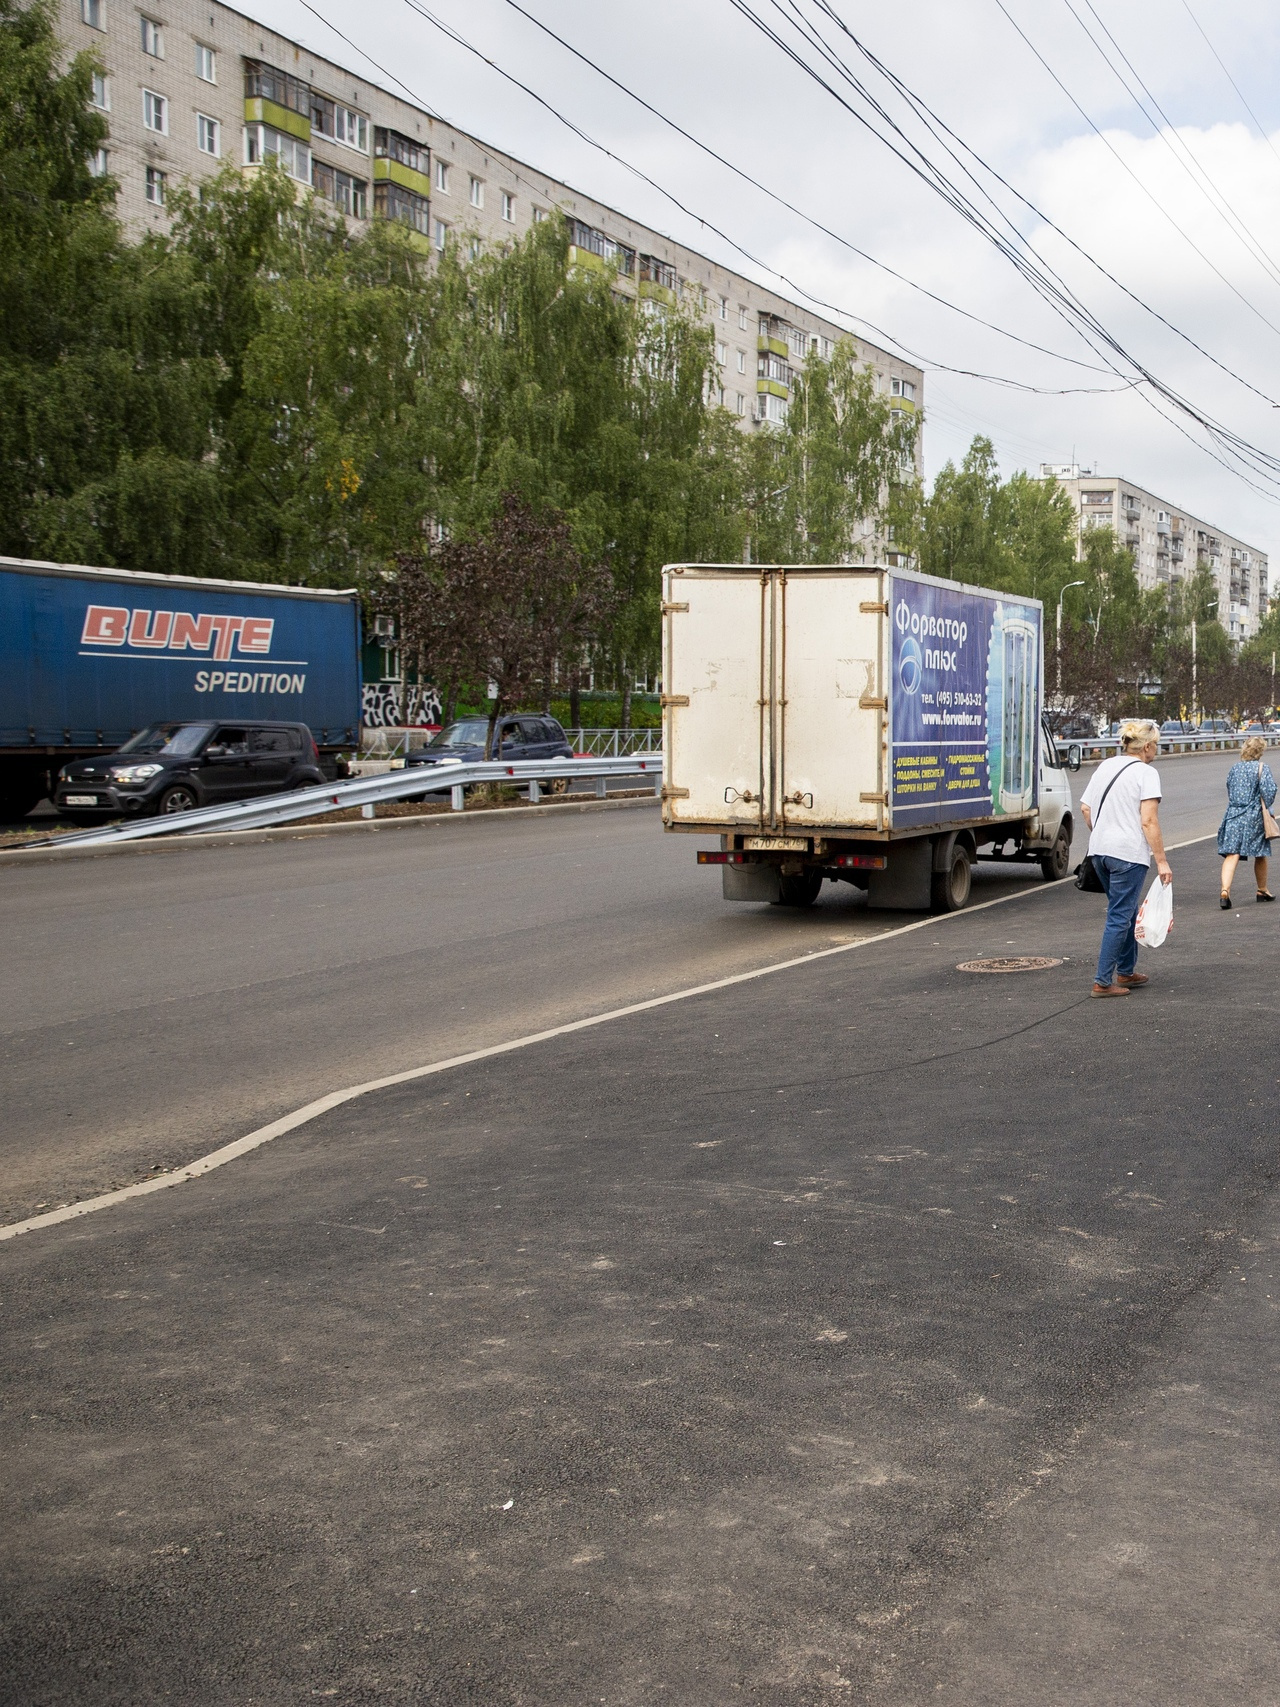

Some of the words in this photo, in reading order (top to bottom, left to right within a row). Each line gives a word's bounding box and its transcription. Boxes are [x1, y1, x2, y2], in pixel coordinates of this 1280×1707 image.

[81, 604, 275, 662] BUNTE
[896, 598, 968, 648] Форватор
[194, 671, 306, 694] SPEDITION
[922, 694, 934, 704] тел.
[936, 691, 952, 708] (495)
[922, 709, 982, 726] www.forvator.ru
[921, 768, 945, 779] СМЕСИТЕИ
